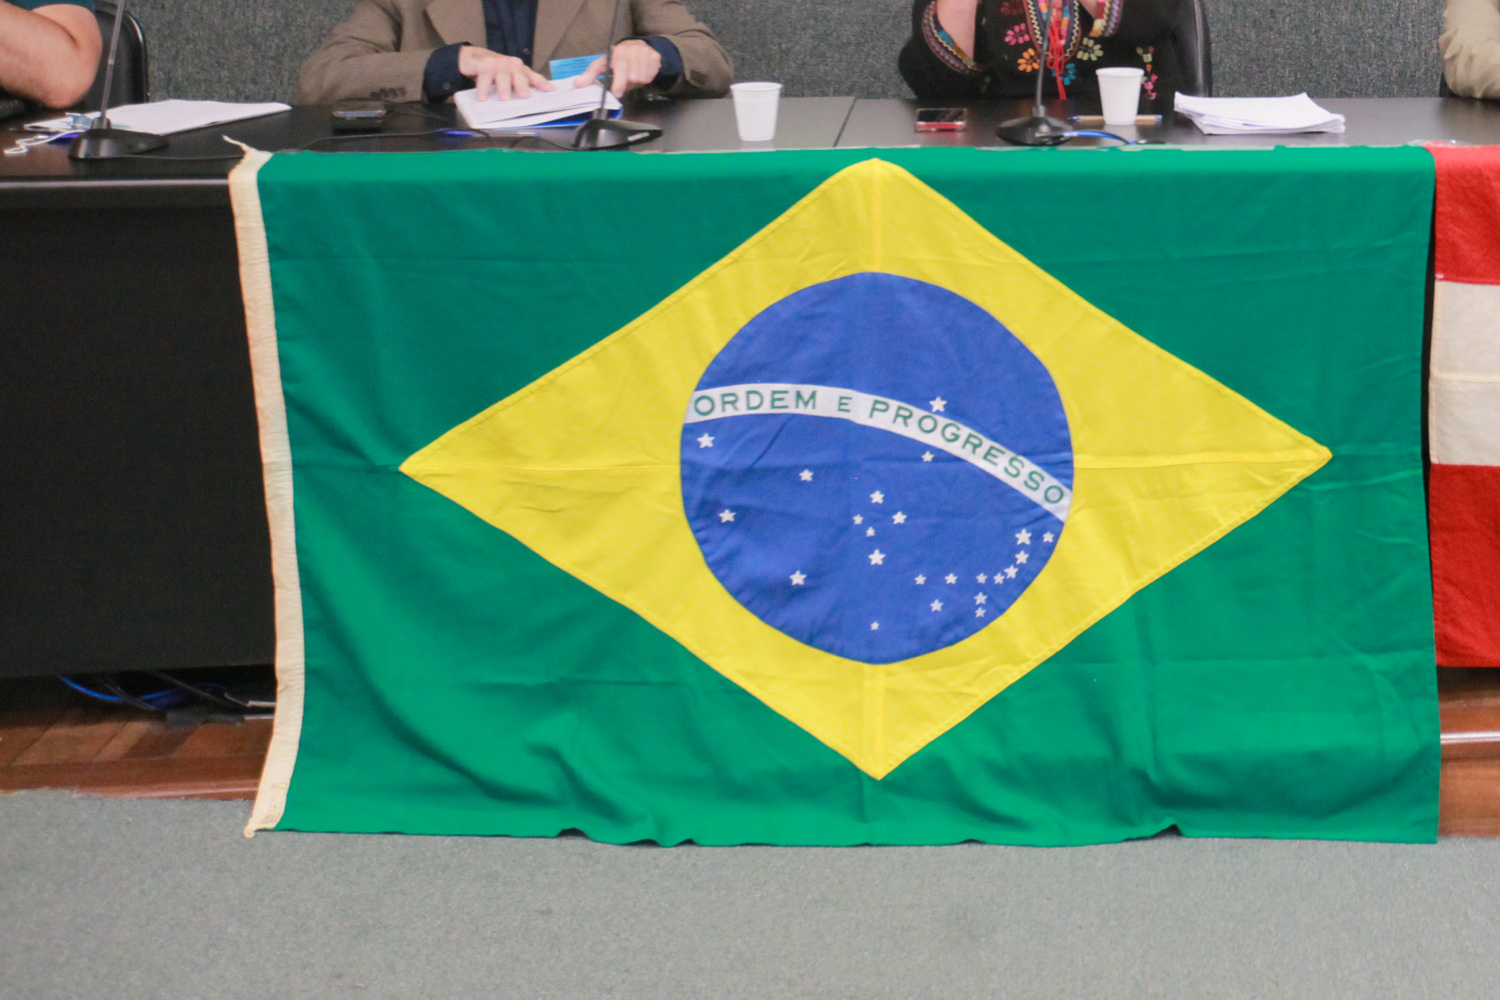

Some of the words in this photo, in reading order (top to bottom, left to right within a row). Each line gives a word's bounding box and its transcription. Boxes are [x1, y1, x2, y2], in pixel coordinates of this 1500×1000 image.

[694, 390, 817, 417] ORDEM
[837, 396, 853, 412] E
[869, 400, 1065, 504] PROGRESSO
